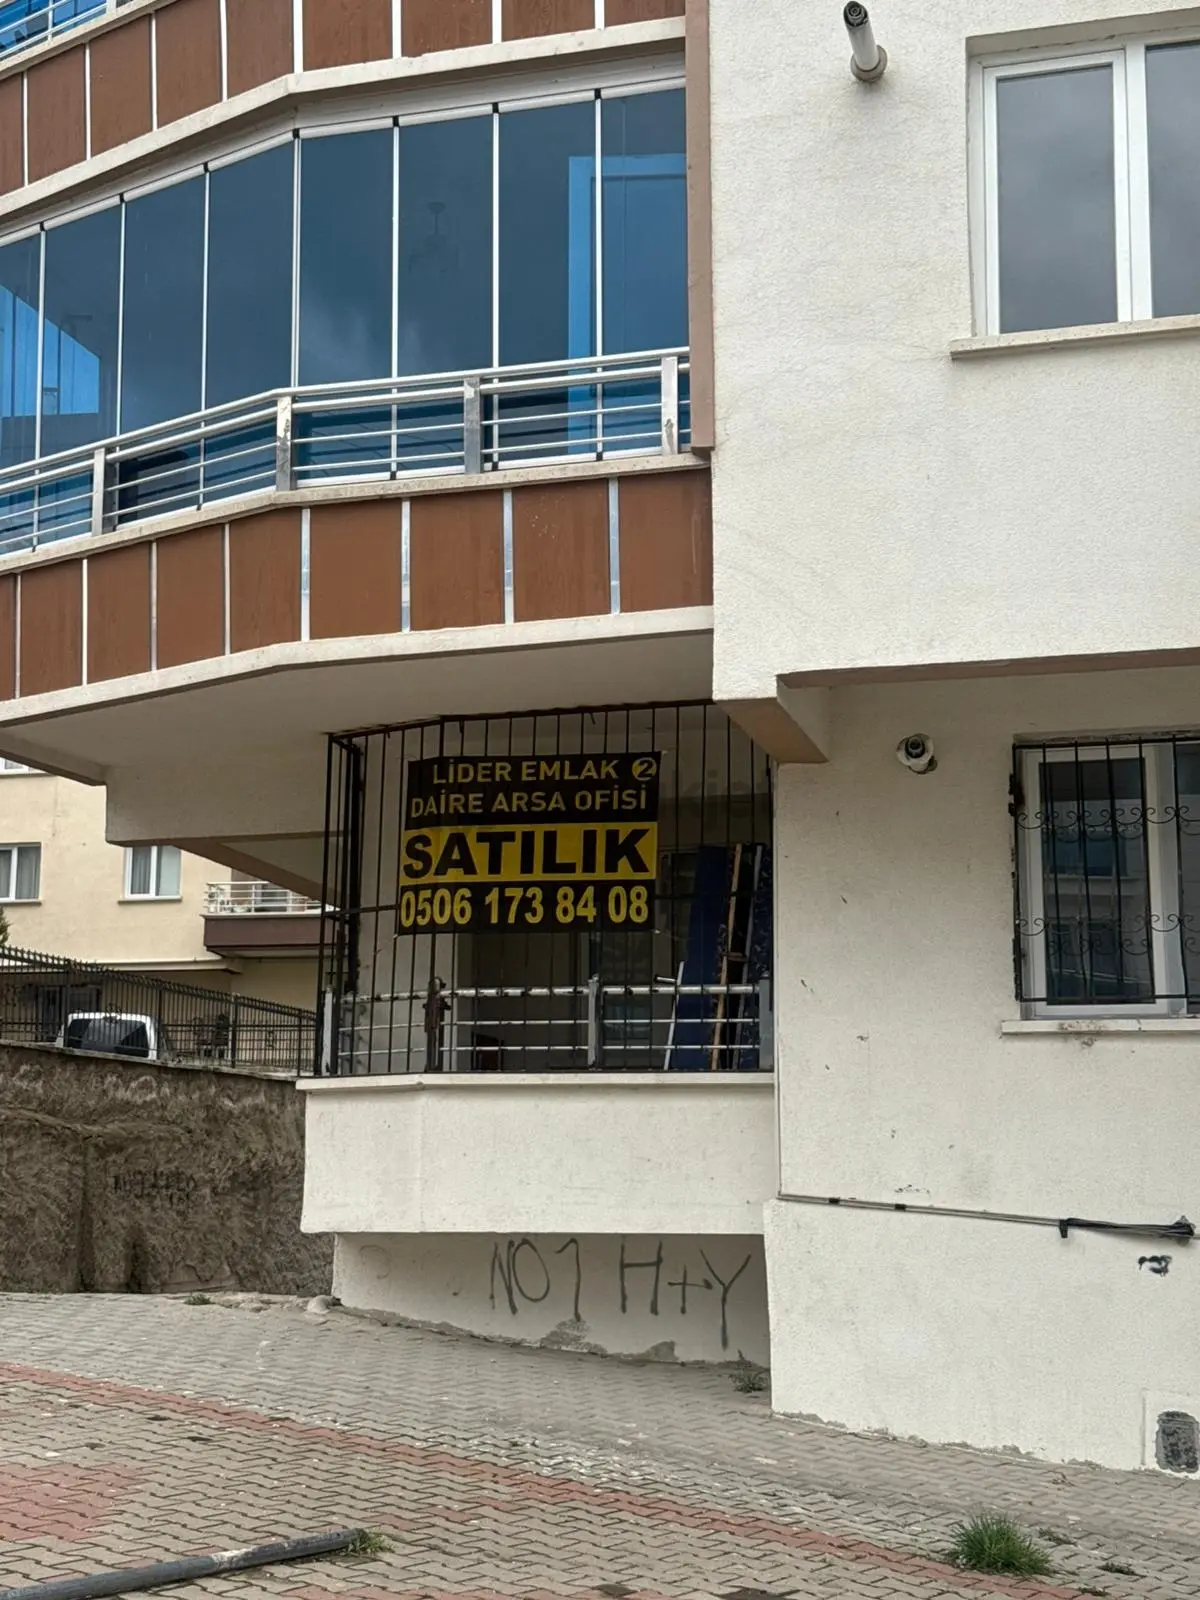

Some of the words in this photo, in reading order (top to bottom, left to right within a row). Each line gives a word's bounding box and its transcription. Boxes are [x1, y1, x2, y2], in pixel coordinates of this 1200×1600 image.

[433, 759, 511, 784] LİDER
[521, 759, 619, 781] EMLAK
[411, 789, 484, 818] DAİRE
[491, 791, 566, 813] ARSA
[575, 784, 647, 810] OFİSİ
[403, 829, 650, 879] SATILIK
[401, 887, 473, 928] 0506
[485, 887, 544, 923] 173
[556, 886, 597, 923] 84
[608, 885, 649, 923] 08
